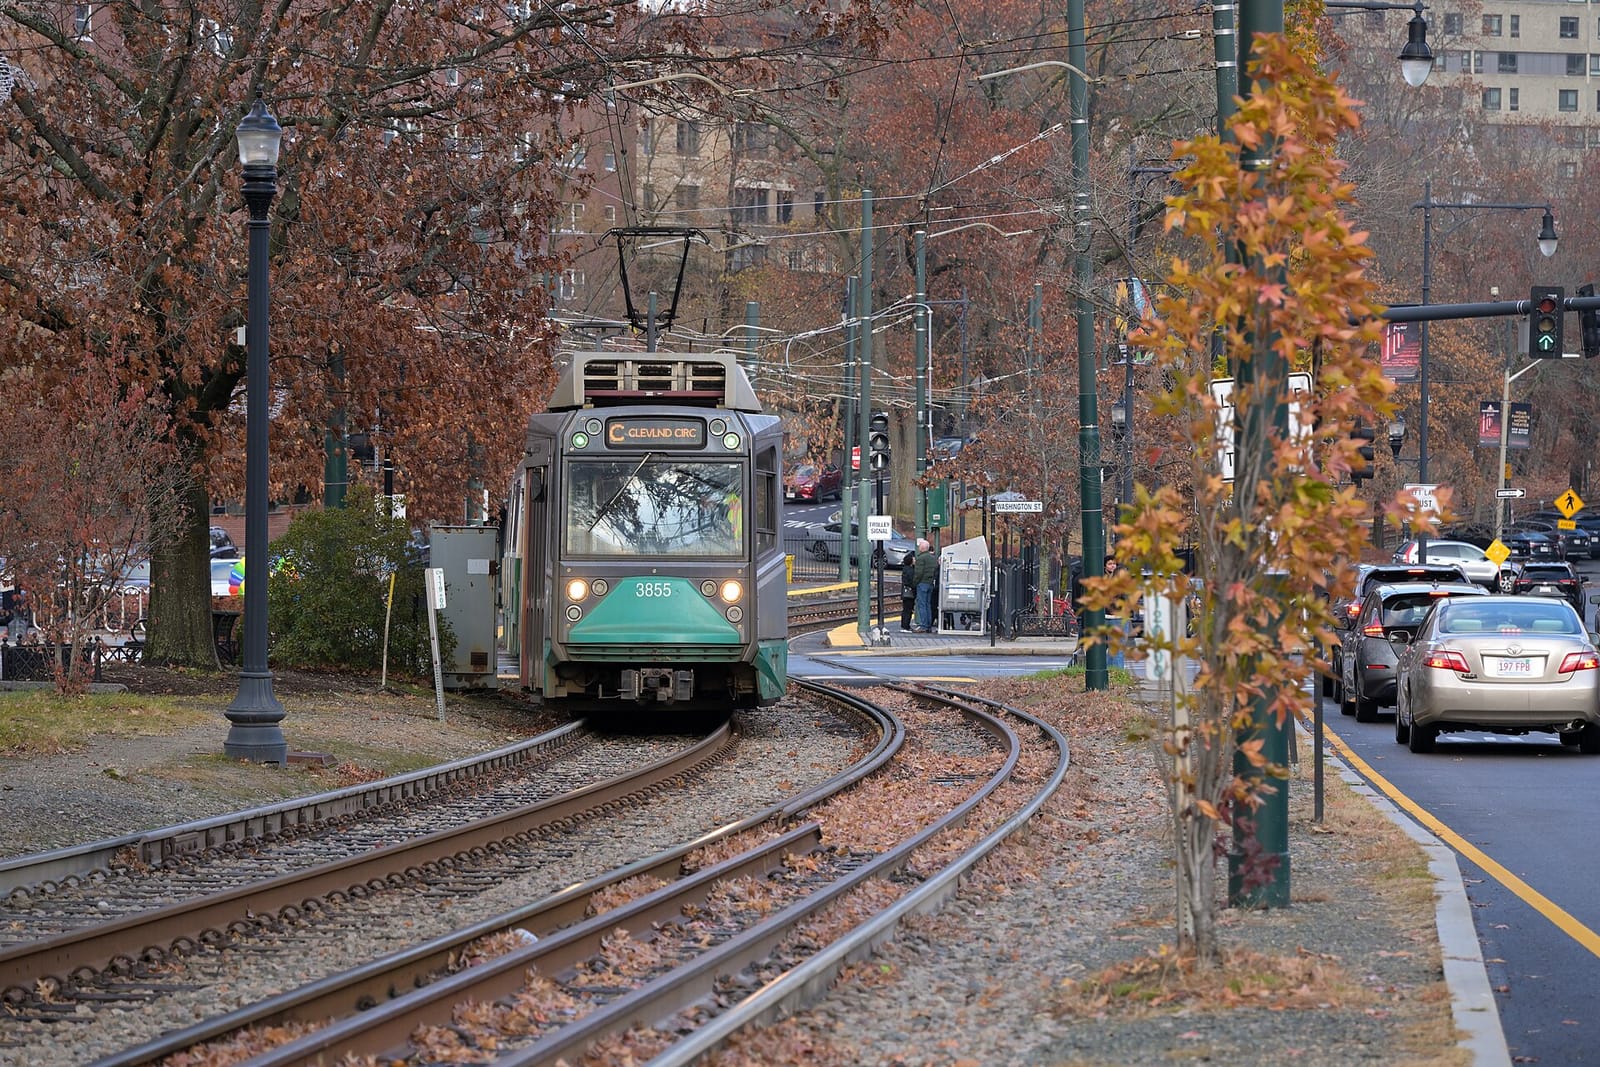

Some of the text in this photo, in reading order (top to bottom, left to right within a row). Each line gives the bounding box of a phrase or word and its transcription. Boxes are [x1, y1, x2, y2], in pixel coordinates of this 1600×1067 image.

[609, 423, 625, 442] C
[674, 428, 697, 438] CIRC
[636, 583, 672, 597] 3855
[1499, 662, 1513, 671] 197
